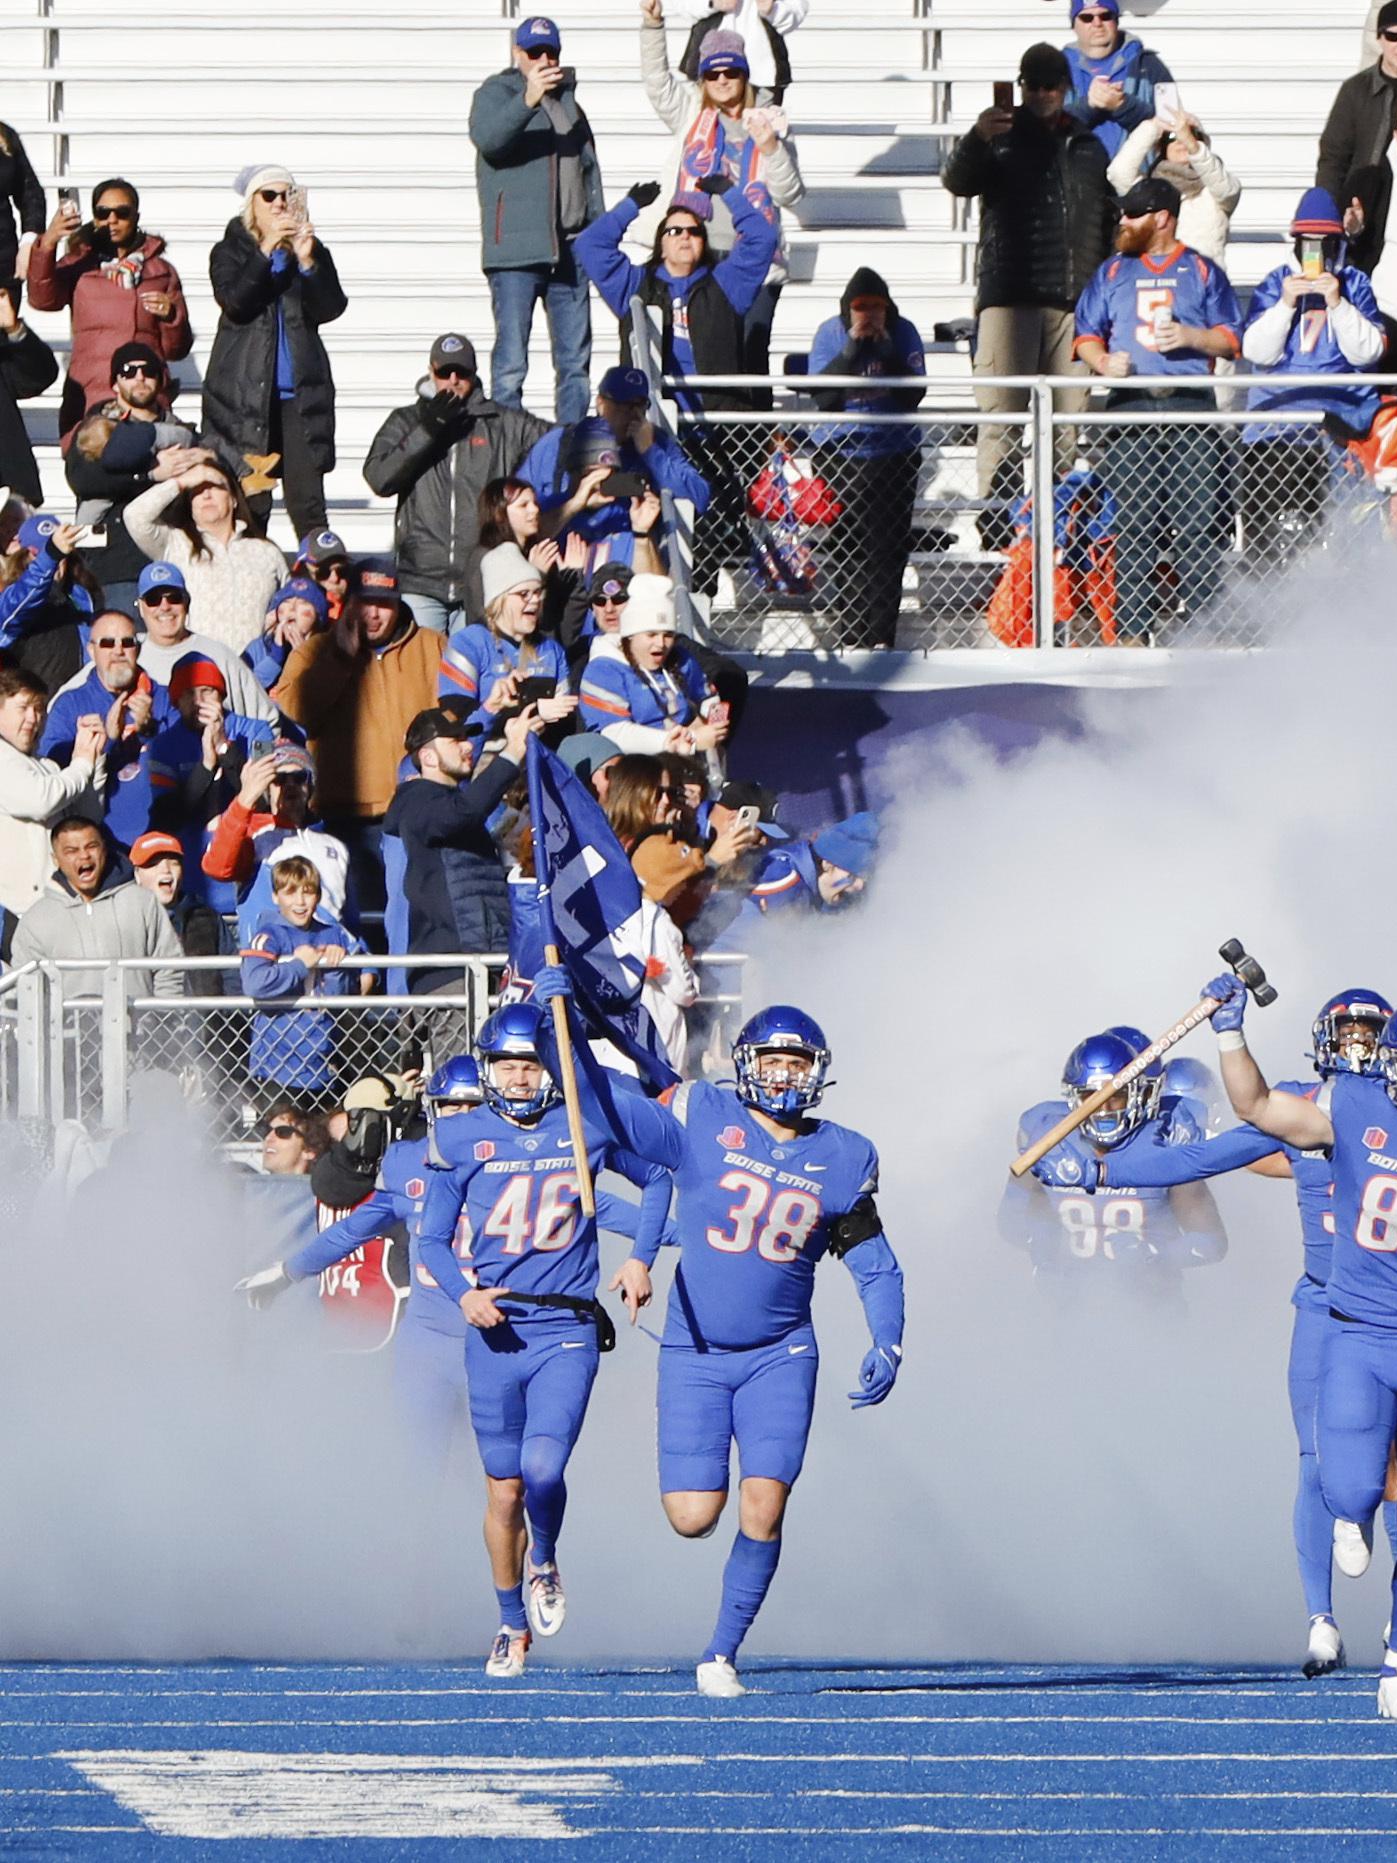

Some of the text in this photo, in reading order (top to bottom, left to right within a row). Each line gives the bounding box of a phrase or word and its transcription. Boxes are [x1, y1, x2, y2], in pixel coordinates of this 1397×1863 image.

[1135, 288, 1175, 351] 5
[483, 1160, 531, 1173] BOISE
[722, 1151, 823, 1195] BOISE STATE
[483, 1171, 581, 1256] 46
[704, 1168, 821, 1264] 38
